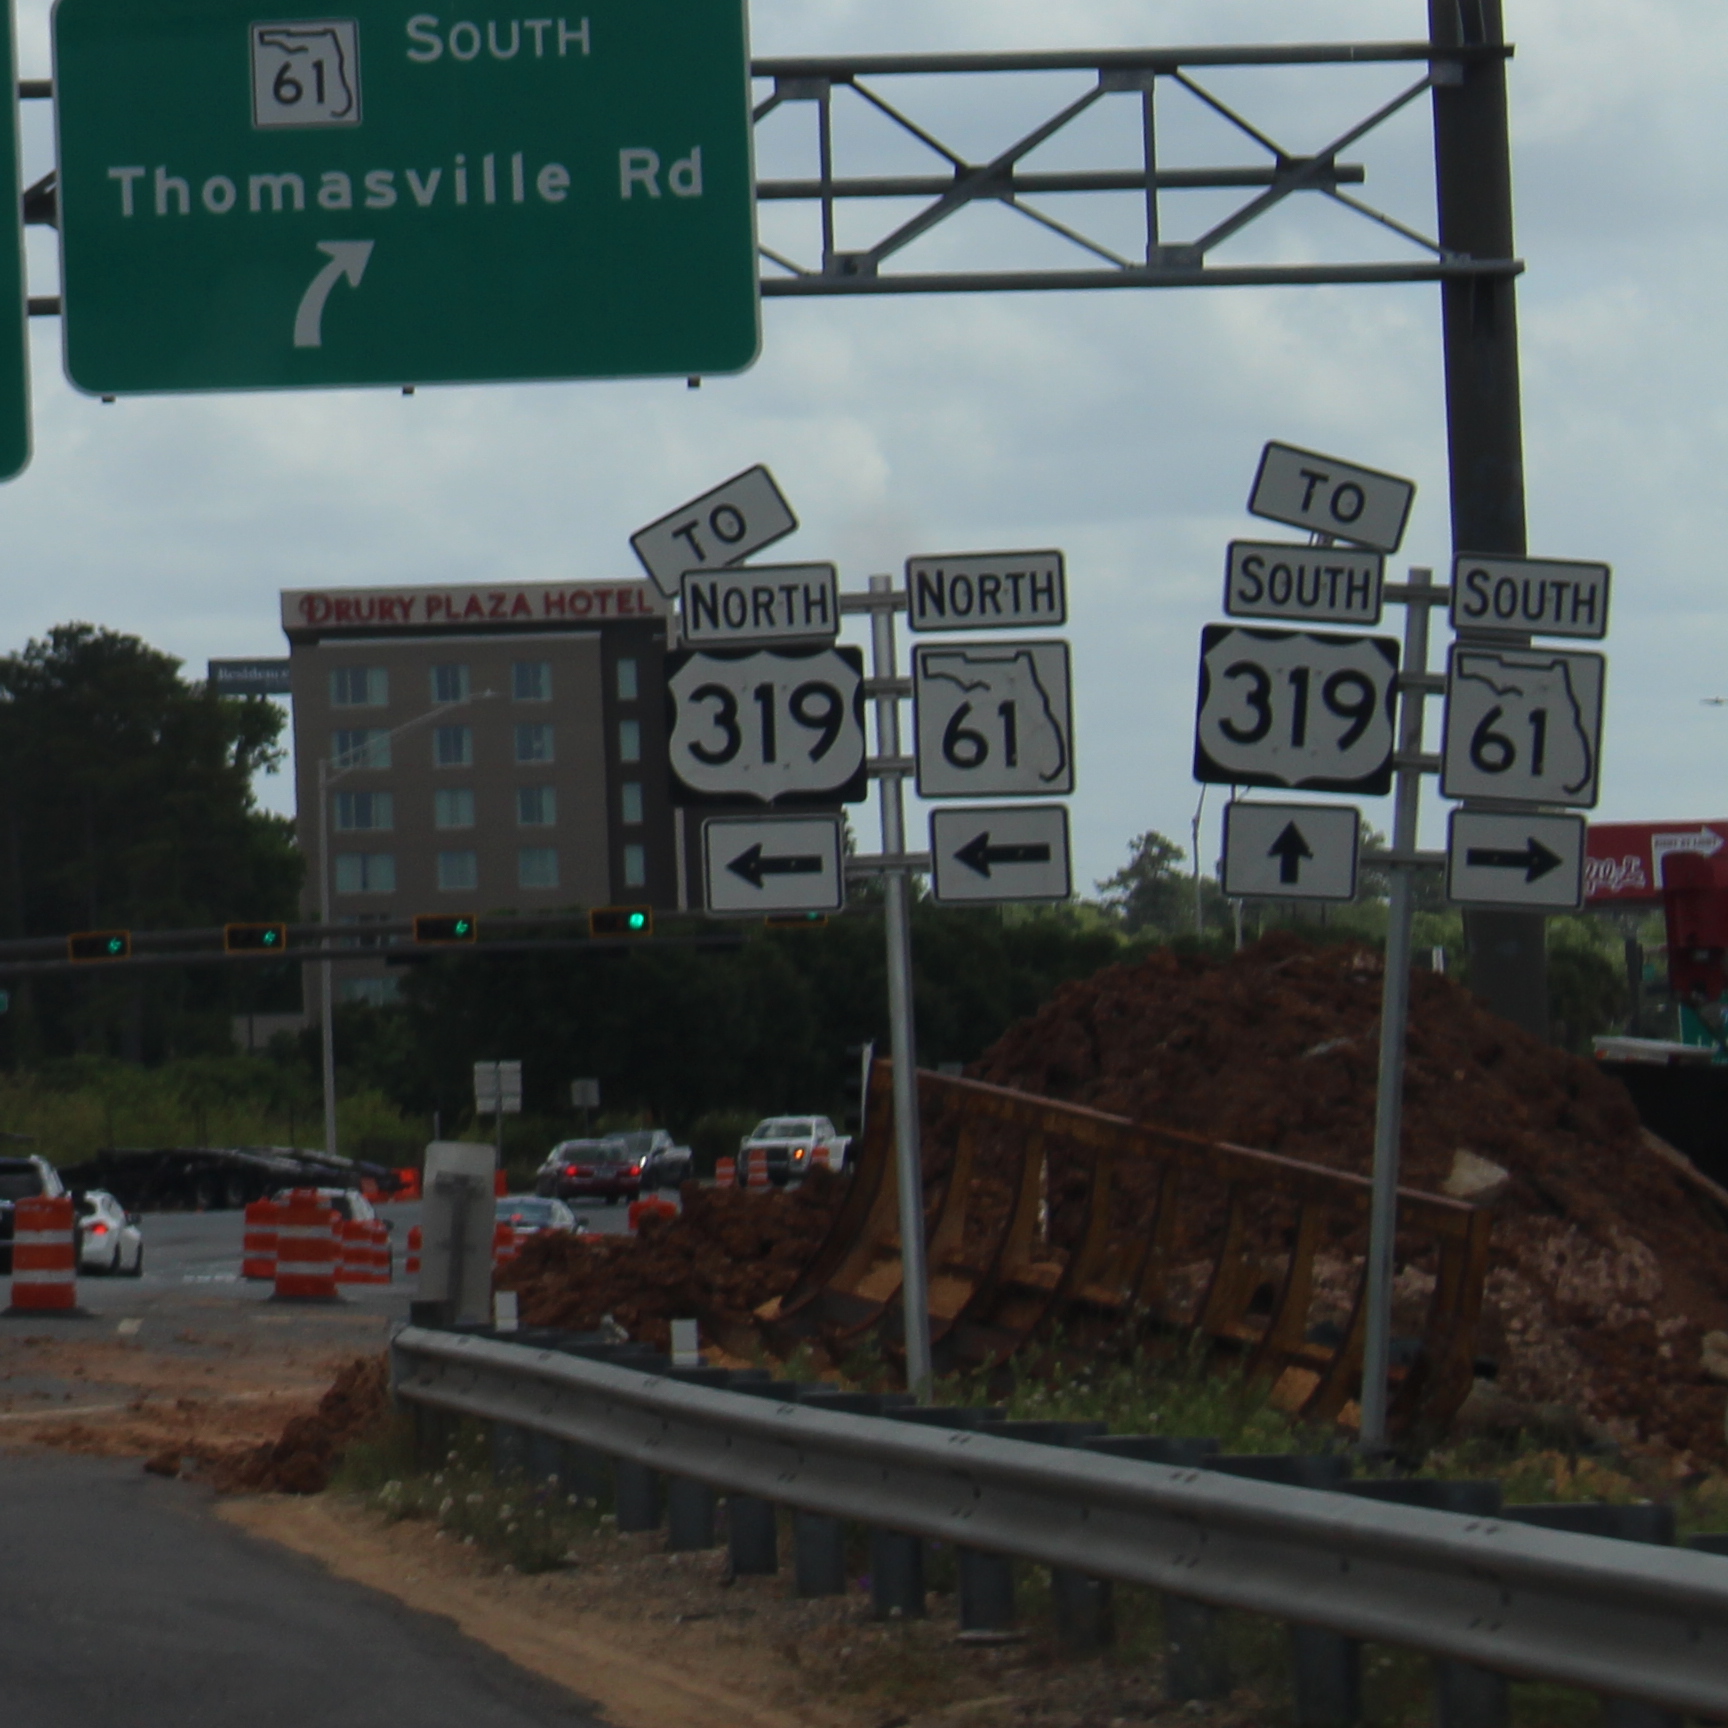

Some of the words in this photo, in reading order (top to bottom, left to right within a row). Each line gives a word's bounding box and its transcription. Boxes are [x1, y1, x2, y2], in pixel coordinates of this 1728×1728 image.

[272, 60, 325, 106] 61
[406, 15, 592, 63] SOUTH
[108, 148, 571, 216] Thomasville
[619, 146, 704, 200] Rd
[1299, 468, 1366, 524] TO
[672, 502, 747, 563] TO
[299, 591, 416, 625] DRURY
[425, 590, 533, 621] PLAZA
[544, 587, 655, 617] HOTEL
[689, 581, 830, 631] NORTH
[916, 570, 1056, 619] NORTH
[1238, 554, 1371, 611] SOUTH
[1463, 569, 1598, 627] SOUTH
[687, 680, 844, 766] 319
[943, 699, 1018, 769] 61
[1219, 660, 1378, 752] 319
[1469, 706, 1548, 777] 61
